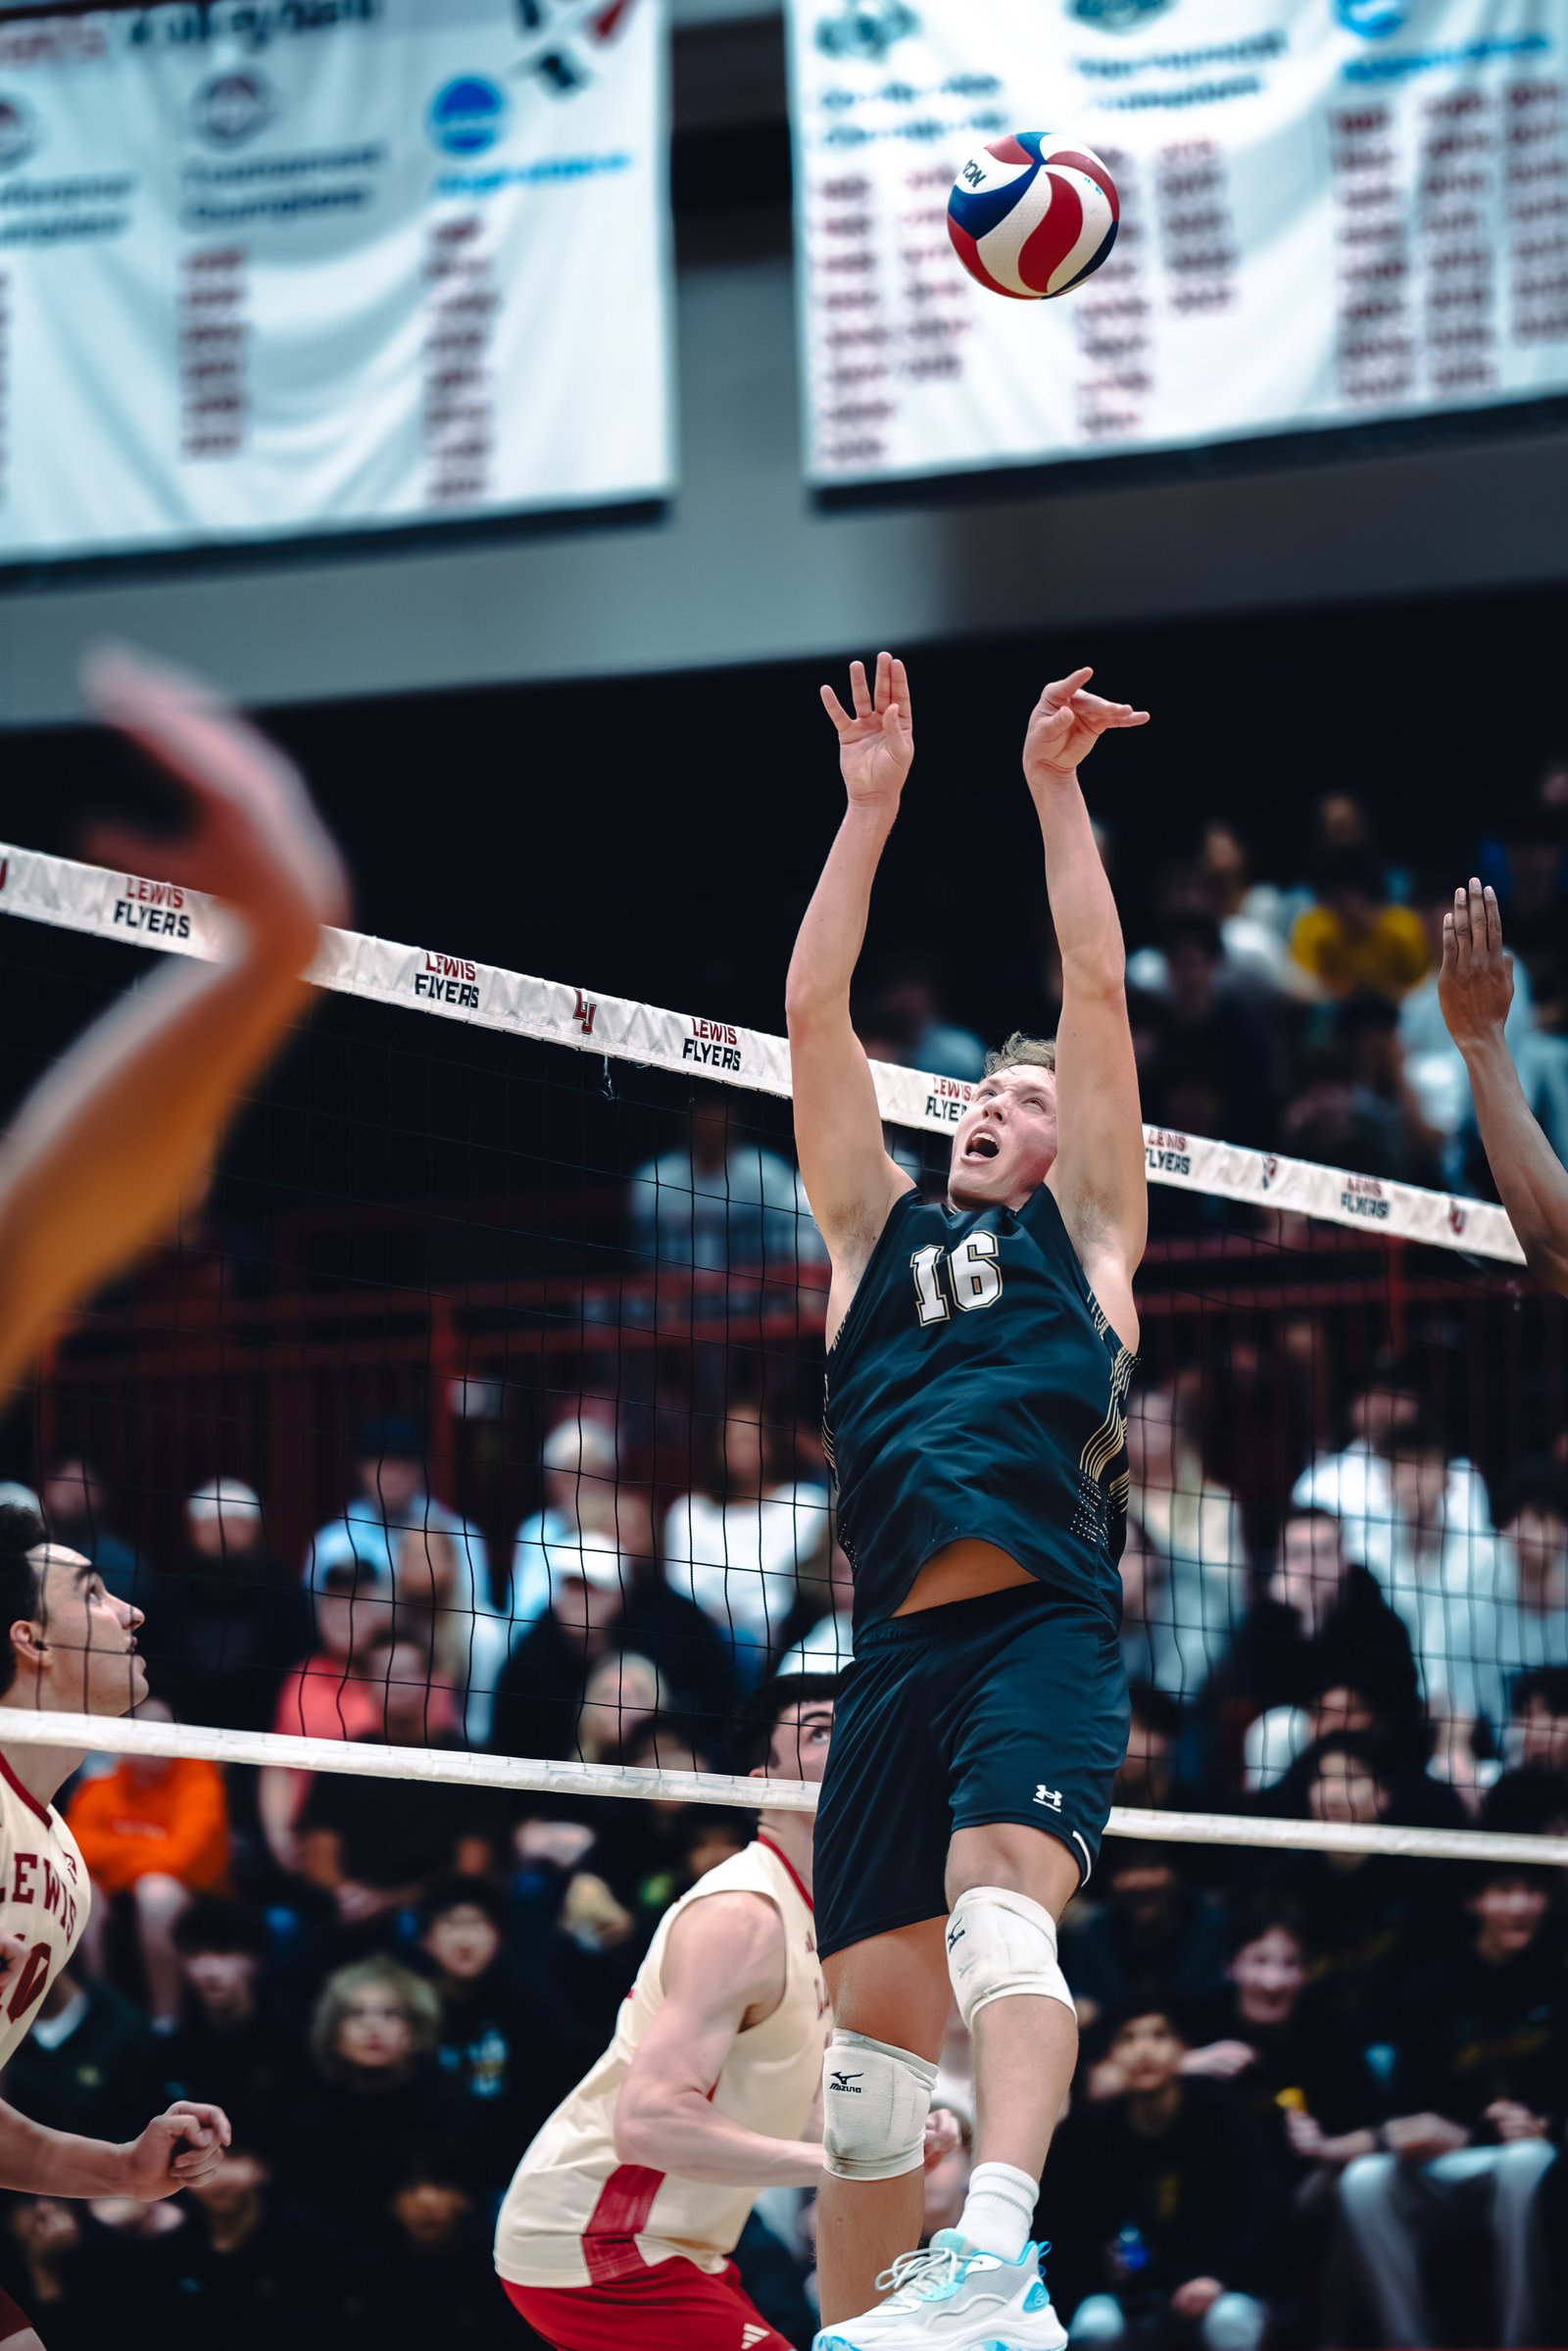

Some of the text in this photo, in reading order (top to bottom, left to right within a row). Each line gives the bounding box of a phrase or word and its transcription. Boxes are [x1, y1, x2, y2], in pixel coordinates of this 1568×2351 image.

[126, 876, 184, 908] LEWIS
[114, 900, 191, 940] FLYERS
[424, 952, 476, 981] LEWIS
[414, 973, 480, 1008] FLYERS
[691, 1017, 738, 1046] LEWIS
[682, 1038, 742, 1071] FLYERS
[932, 1077, 973, 1102] LEWIS
[925, 1096, 968, 1122] FLYE
[1148, 1129, 1188, 1153] LEWIS
[1145, 1149, 1192, 1175] LYERS
[909, 1230, 1003, 1327] 16
[0, 1851, 76, 1946] EWIS
[0, 1934, 51, 2025] 0
